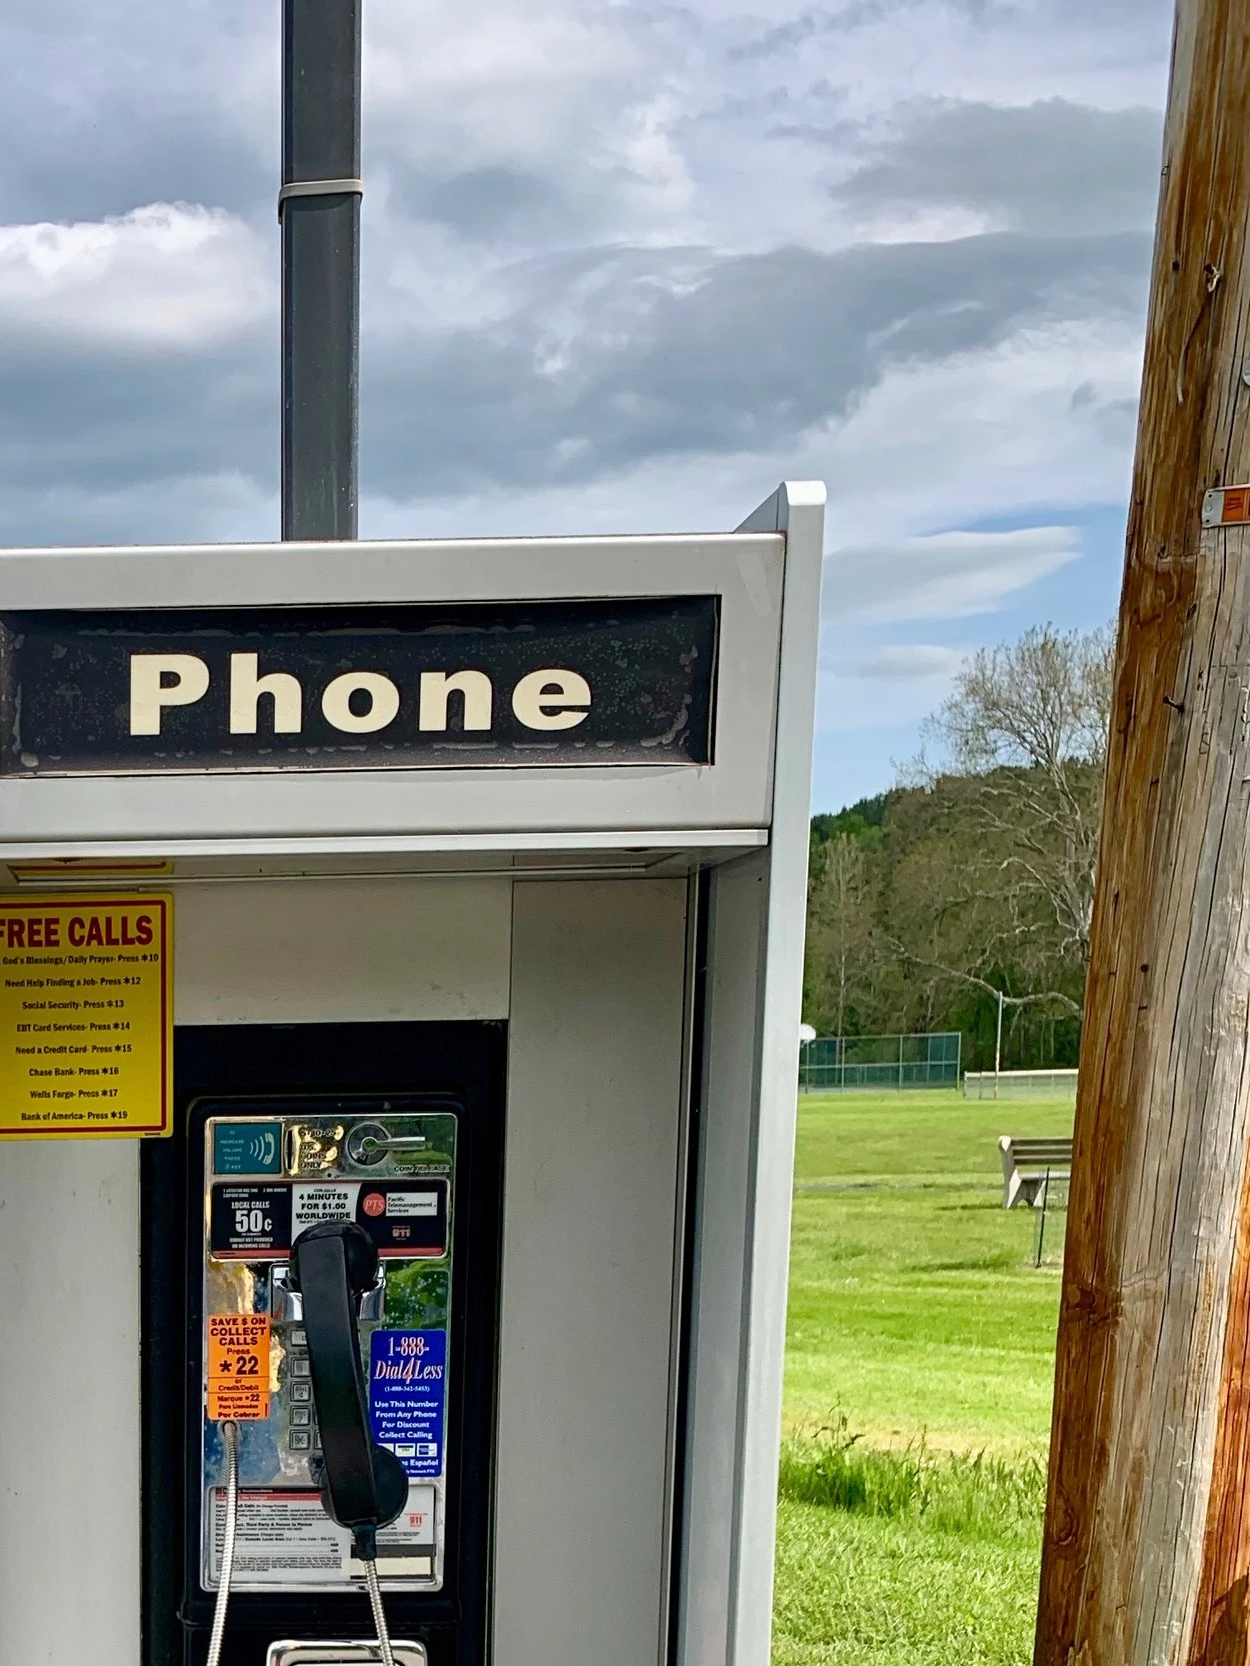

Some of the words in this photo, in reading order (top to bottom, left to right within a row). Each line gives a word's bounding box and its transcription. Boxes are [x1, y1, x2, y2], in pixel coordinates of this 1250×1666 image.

[129, 652, 592, 736] Phone
[68, 914, 154, 948] CALLS
[117, 953, 140, 963] Press
[5, 979, 25, 988] Need
[26, 979, 45, 989] Help
[46, 978, 75, 988] Finding
[100, 976, 121, 986] Press
[22, 1001, 46, 1010] Social
[83, 1000, 105, 1009] Press
[16, 1023, 32, 1032] EBT
[33, 1023, 52, 1032] Card
[89, 1022, 111, 1031] Press
[15, 1045, 36, 1055] Need
[43, 1045, 68, 1055] Credit
[91, 1044, 113, 1054] Press
[29, 1068, 53, 1077] Chase
[78, 1067, 100, 1076] Press
[30, 1090, 51, 1099] Wells
[78, 1089, 100, 1098] Press
[21, 1112, 41, 1121] Bank
[42, 1111, 51, 1120] of
[87, 1110, 109, 1120] Press
[301, 1152, 326, 1160] COINS
[301, 1161, 322, 1169] ONLY
[393, 1165, 414, 1173] COIN
[299, 1193, 305, 1201] 4
[306, 1193, 349, 1201] MINUTES
[251, 1201, 270, 1209] CALLS
[301, 1202, 319, 1210] FOR
[322, 1202, 346, 1210] $1.00
[364, 1199, 384, 1211] PTS
[296, 1211, 351, 1220] WORLDWIDE
[392, 1228, 411, 1238] 911
[211, 1318, 239, 1326] SAVE
[241, 1317, 248, 1326] $
[251, 1317, 266, 1325] ON
[210, 1327, 267, 1337] COLLECT
[219, 1337, 258, 1346] CALLS
[387, 1336, 430, 1357] 1-888-
[373, 1356, 443, 1385] Dial4Less
[217, 1395, 243, 1403] Marque
[390, 1400, 406, 1408] This
[397, 1411, 411, 1419] Any
[407, 1431, 433, 1439] Calling
[410, 1459, 438, 1467] Español
[410, 1515, 422, 1524] 911
